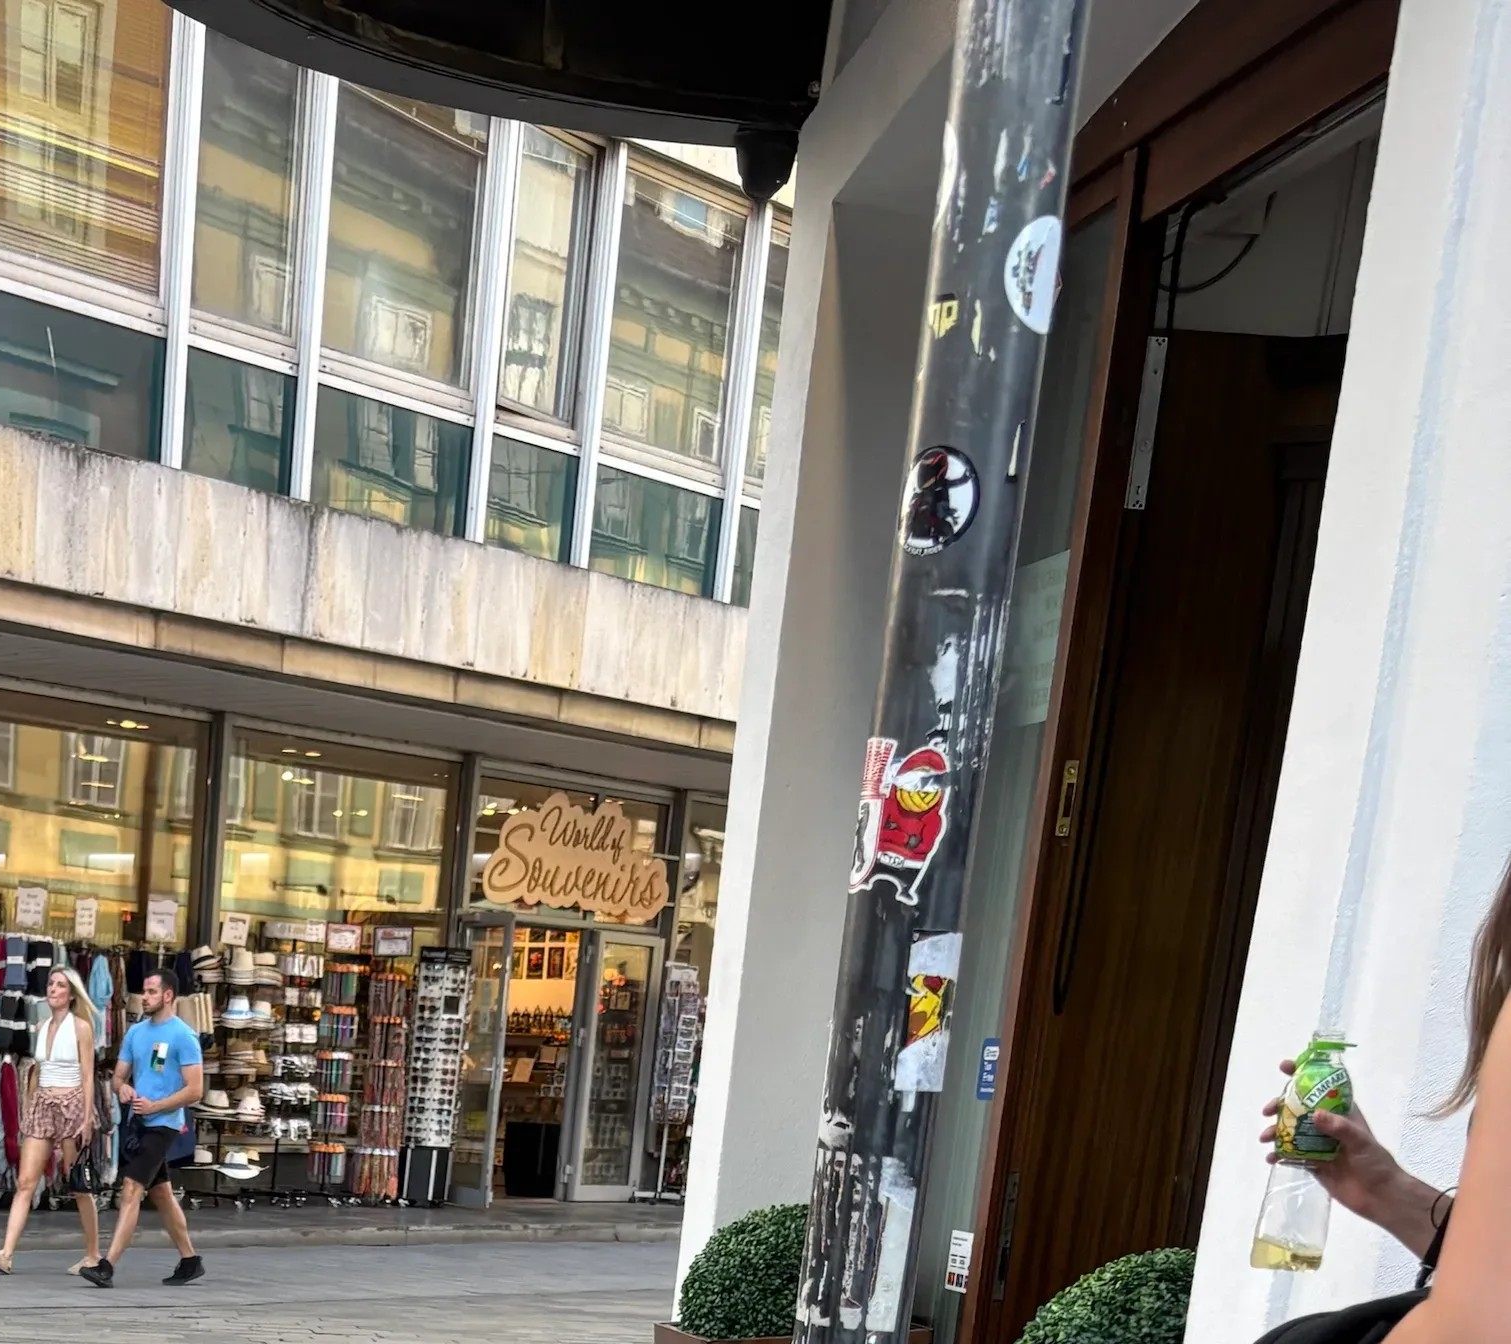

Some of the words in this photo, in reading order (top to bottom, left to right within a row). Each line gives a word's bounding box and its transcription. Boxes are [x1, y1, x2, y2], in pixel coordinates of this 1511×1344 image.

[489, 823, 661, 909] Souvenirs
[541, 805, 615, 852] World
[610, 829, 626, 864] of
